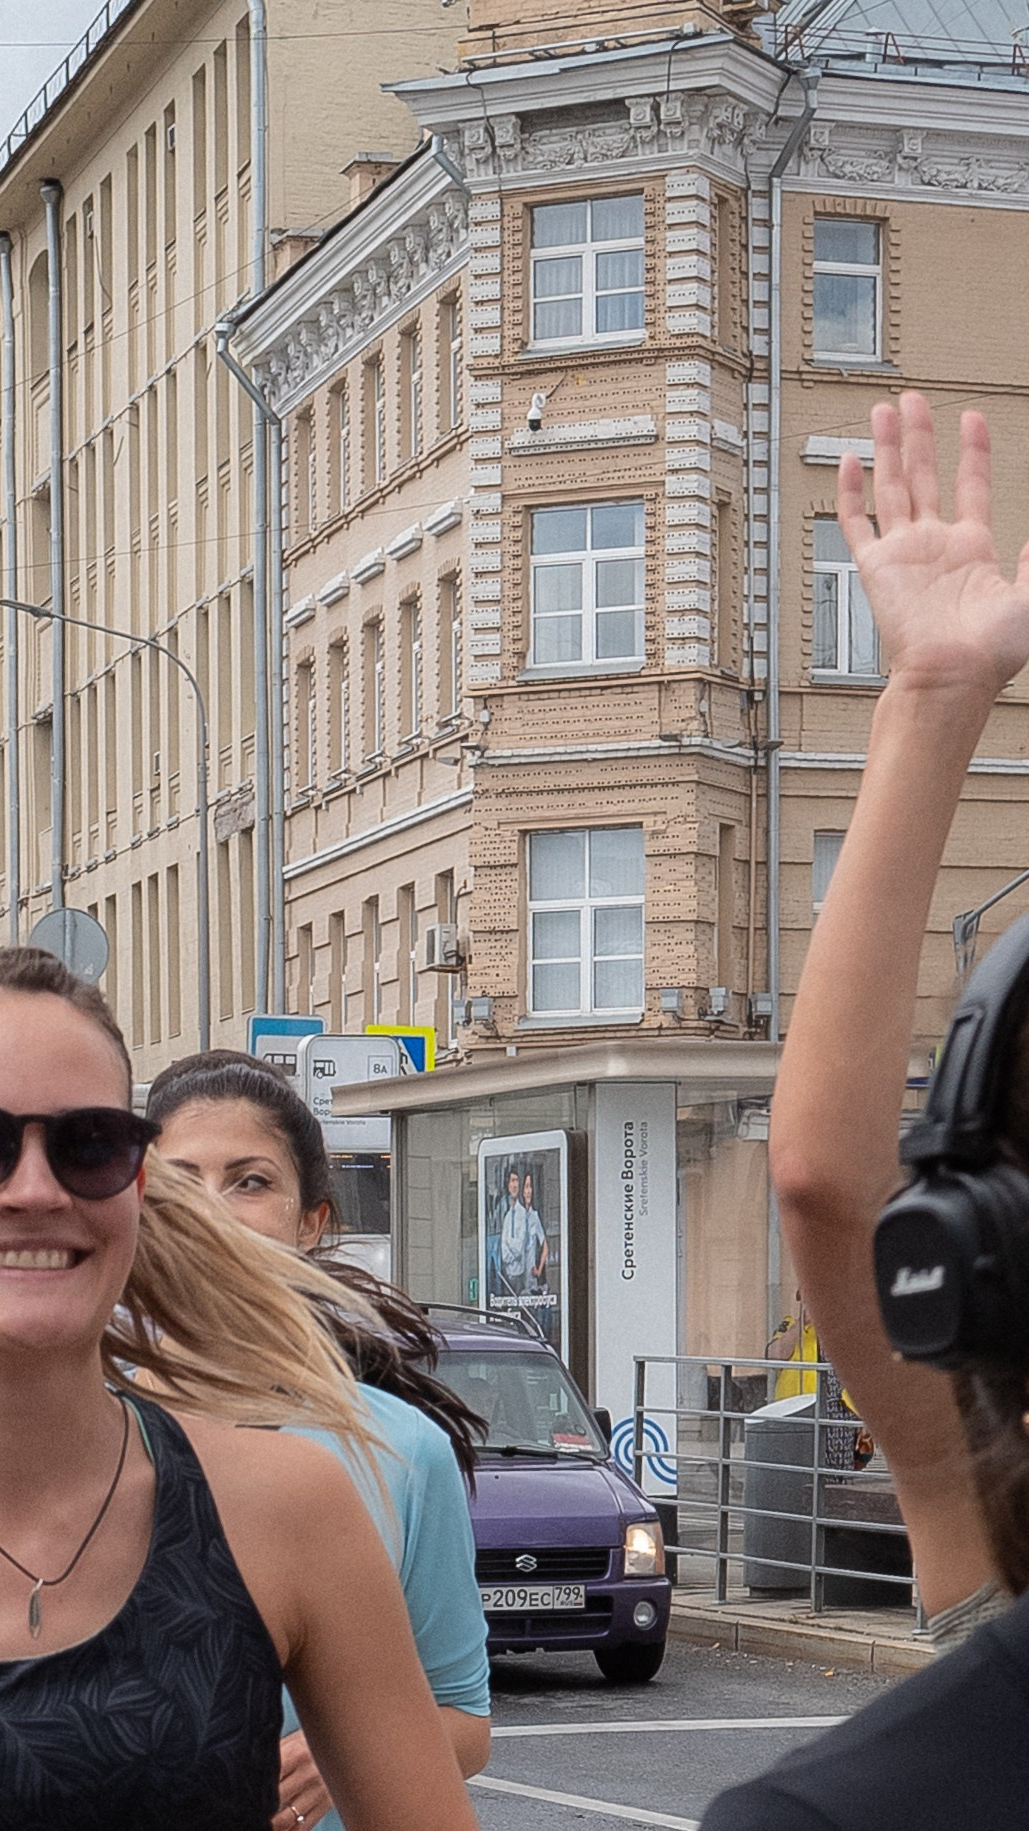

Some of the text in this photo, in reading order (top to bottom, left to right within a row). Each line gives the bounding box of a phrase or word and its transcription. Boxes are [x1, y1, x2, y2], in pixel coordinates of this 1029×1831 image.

[621, 1121, 636, 1280] Сретенские Ворота
[639, 1121, 648, 1216] Sretenskie Vorota
[554, 1586, 581, 1601] 799
